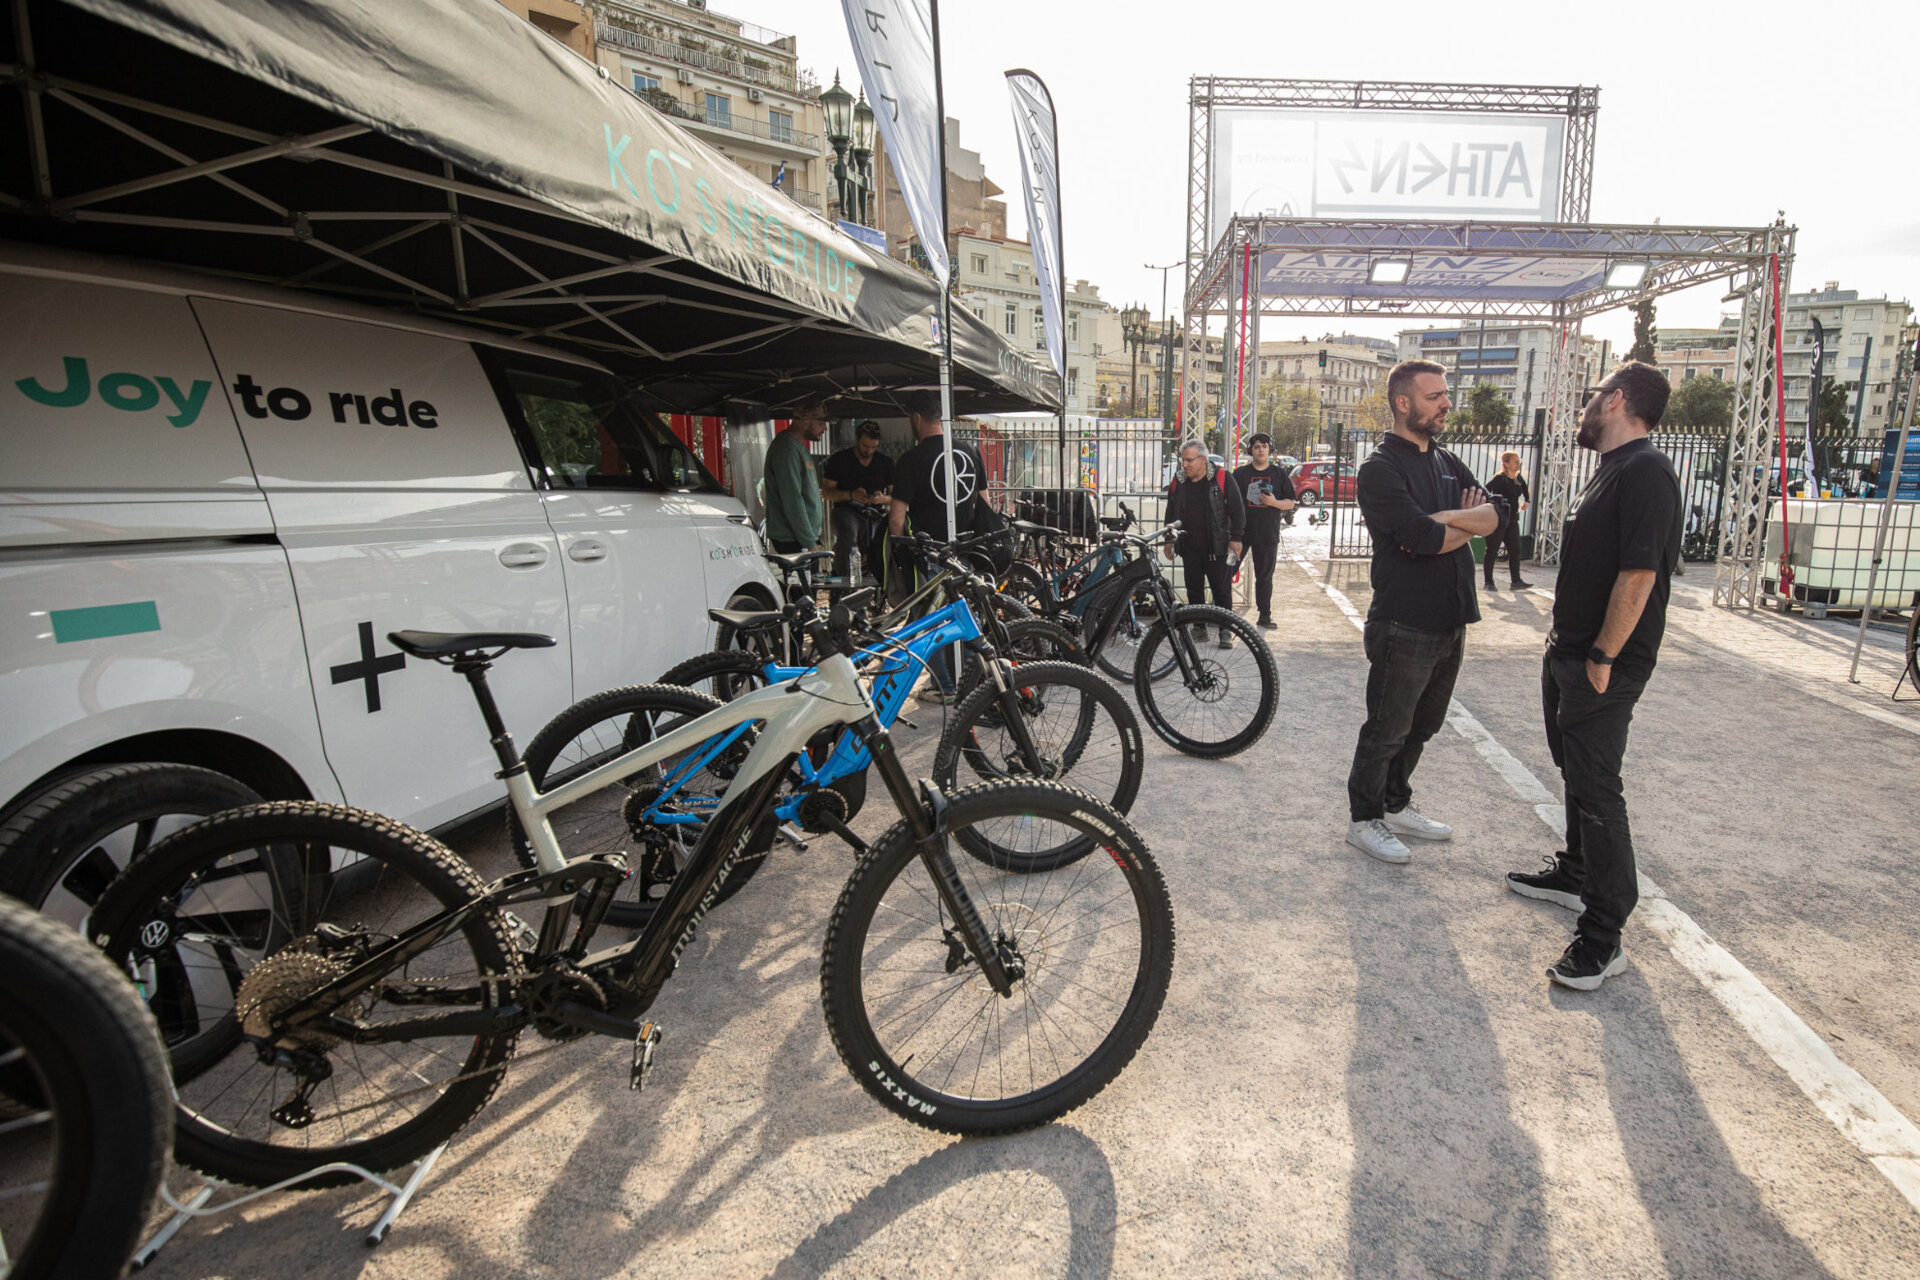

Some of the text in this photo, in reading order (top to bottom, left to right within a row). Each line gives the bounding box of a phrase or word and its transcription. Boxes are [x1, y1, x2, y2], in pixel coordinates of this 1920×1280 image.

[15, 356, 439, 429] Joy to ride
[869, 1060, 938, 1116] MAXXIS
